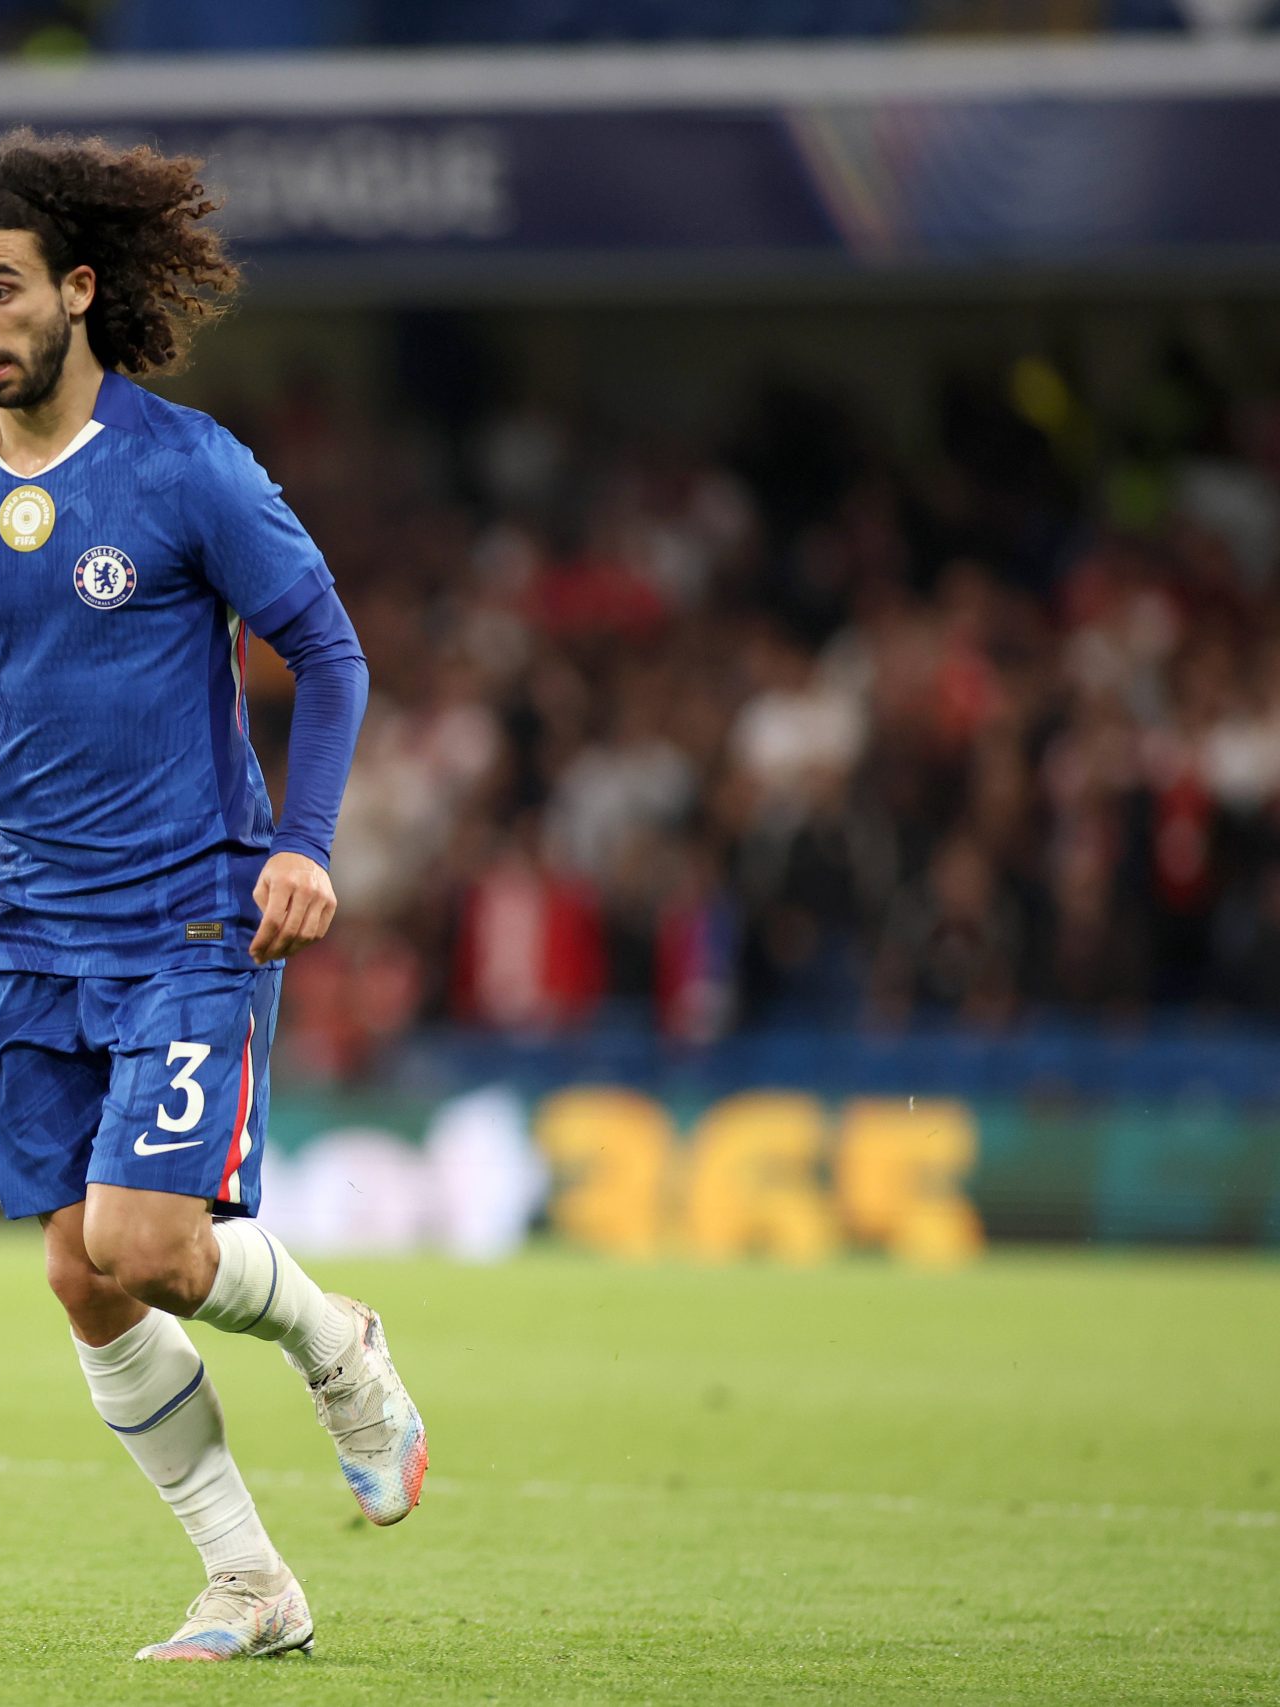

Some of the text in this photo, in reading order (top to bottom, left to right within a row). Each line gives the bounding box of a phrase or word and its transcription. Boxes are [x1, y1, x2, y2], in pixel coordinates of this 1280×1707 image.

[2, 490, 51, 526] WORLD CHAMPIONS
[14, 536, 37, 546] FIFA
[84, 548, 125, 563] CHELSEA
[157, 1041, 211, 1133] 3
